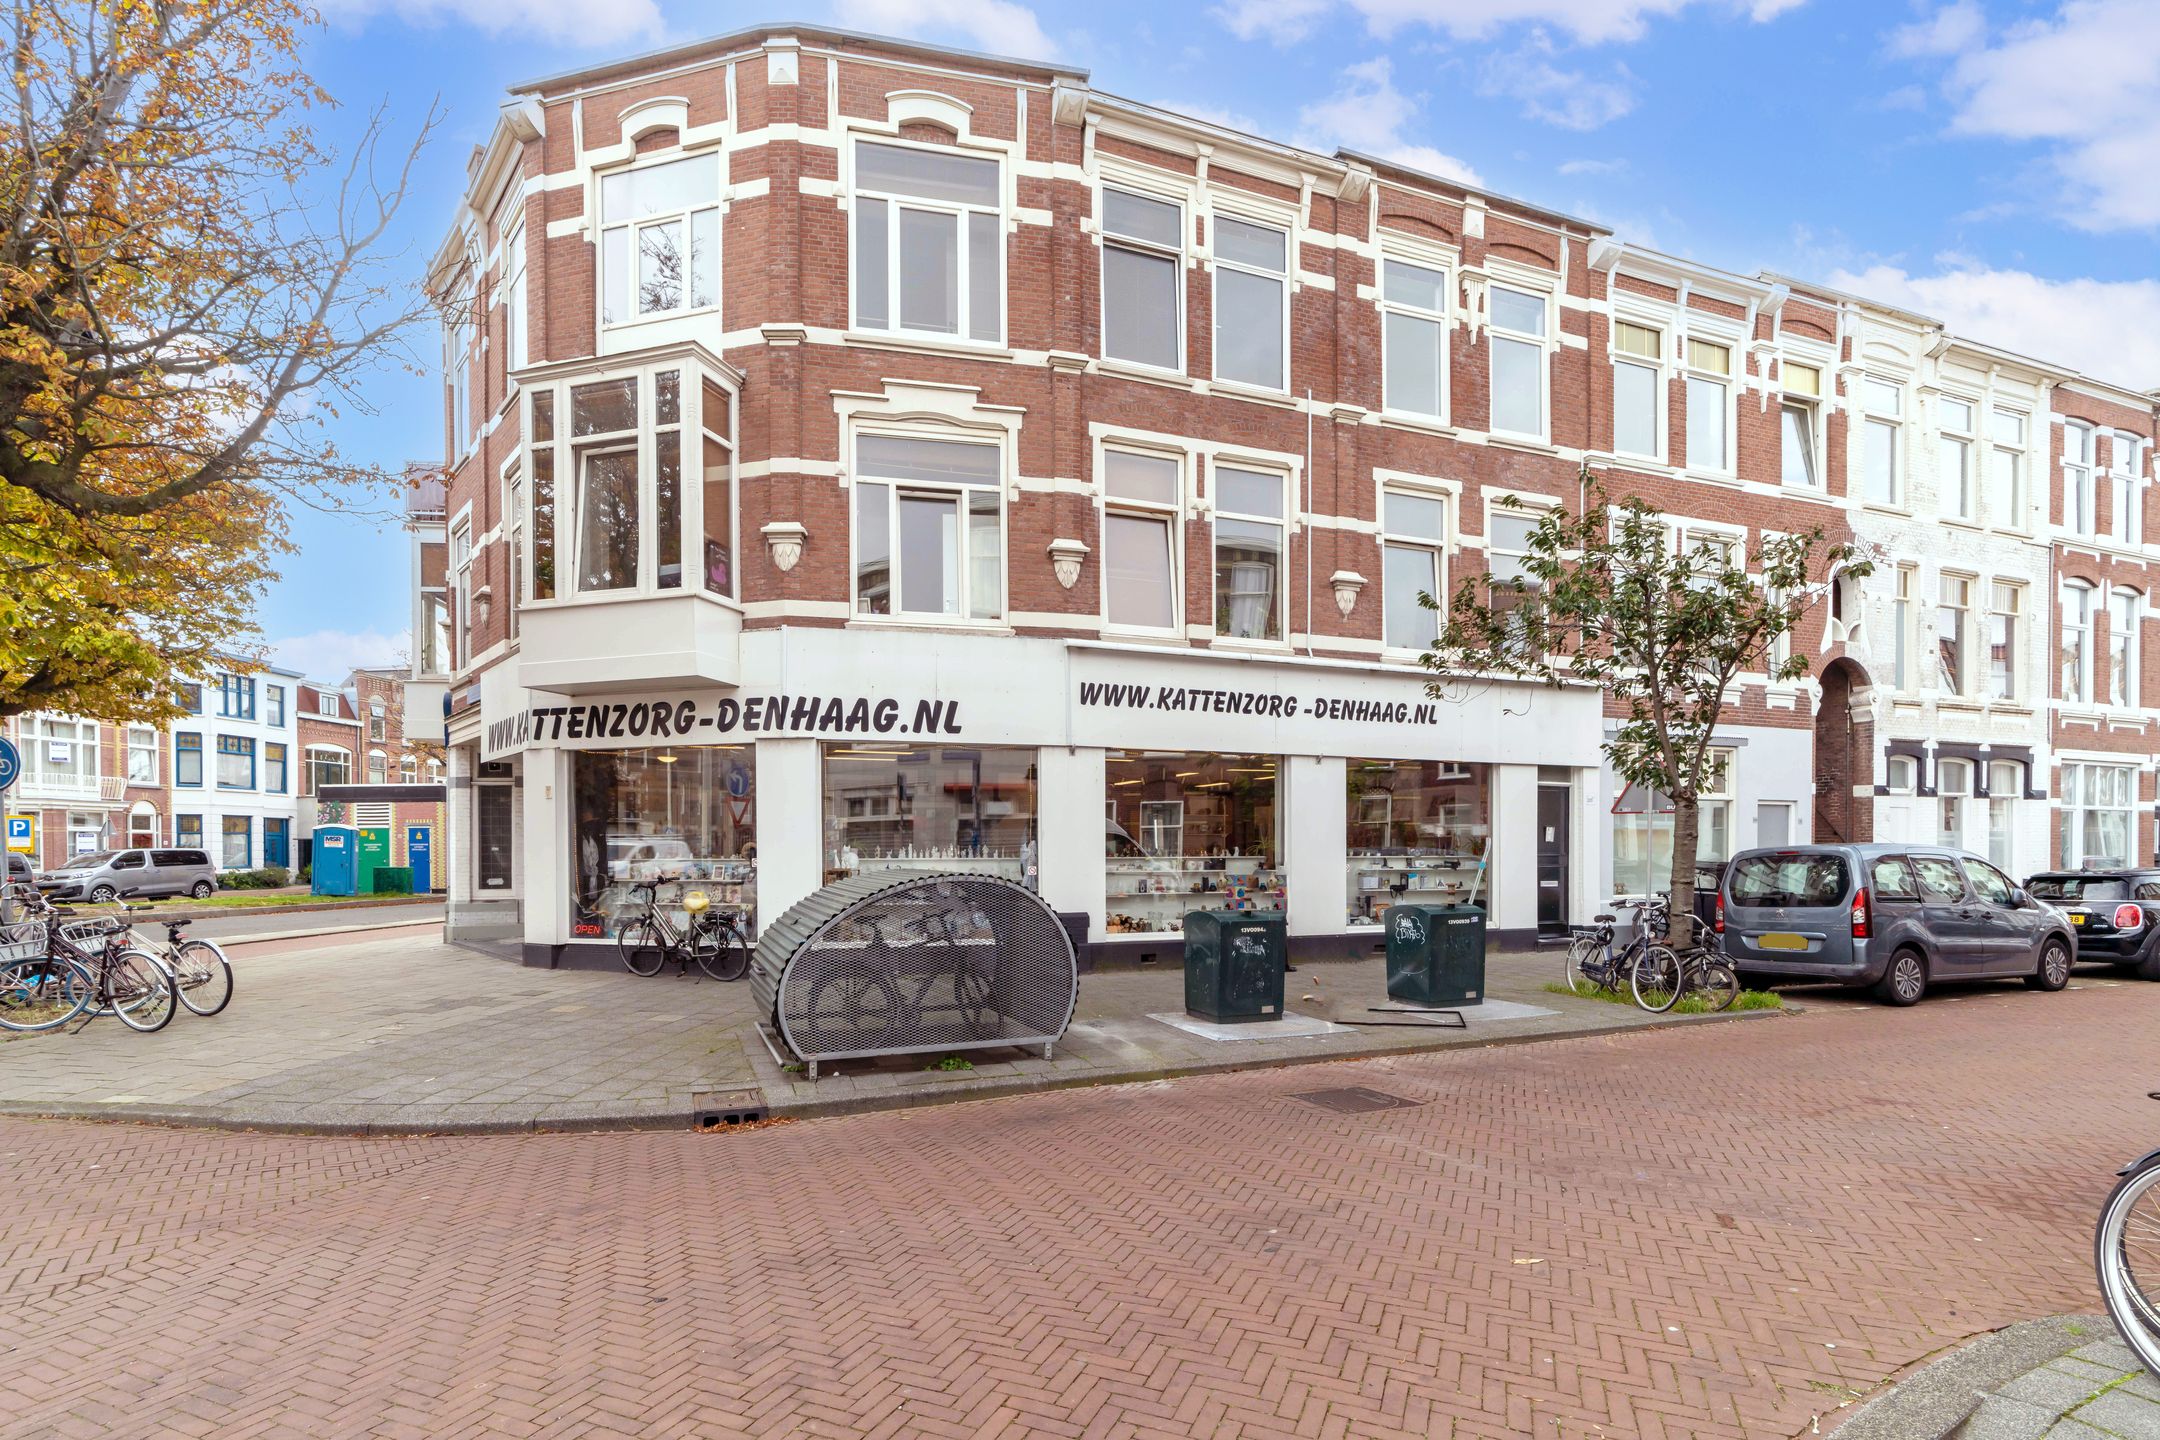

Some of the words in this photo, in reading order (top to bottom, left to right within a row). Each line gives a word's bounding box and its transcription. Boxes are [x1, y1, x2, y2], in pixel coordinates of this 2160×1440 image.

[488, 695, 963, 754] WWW.KATTENZORG-DENHAAG.NL
[13, 821, 26, 836] P
[575, 924, 601, 935] OPEN
